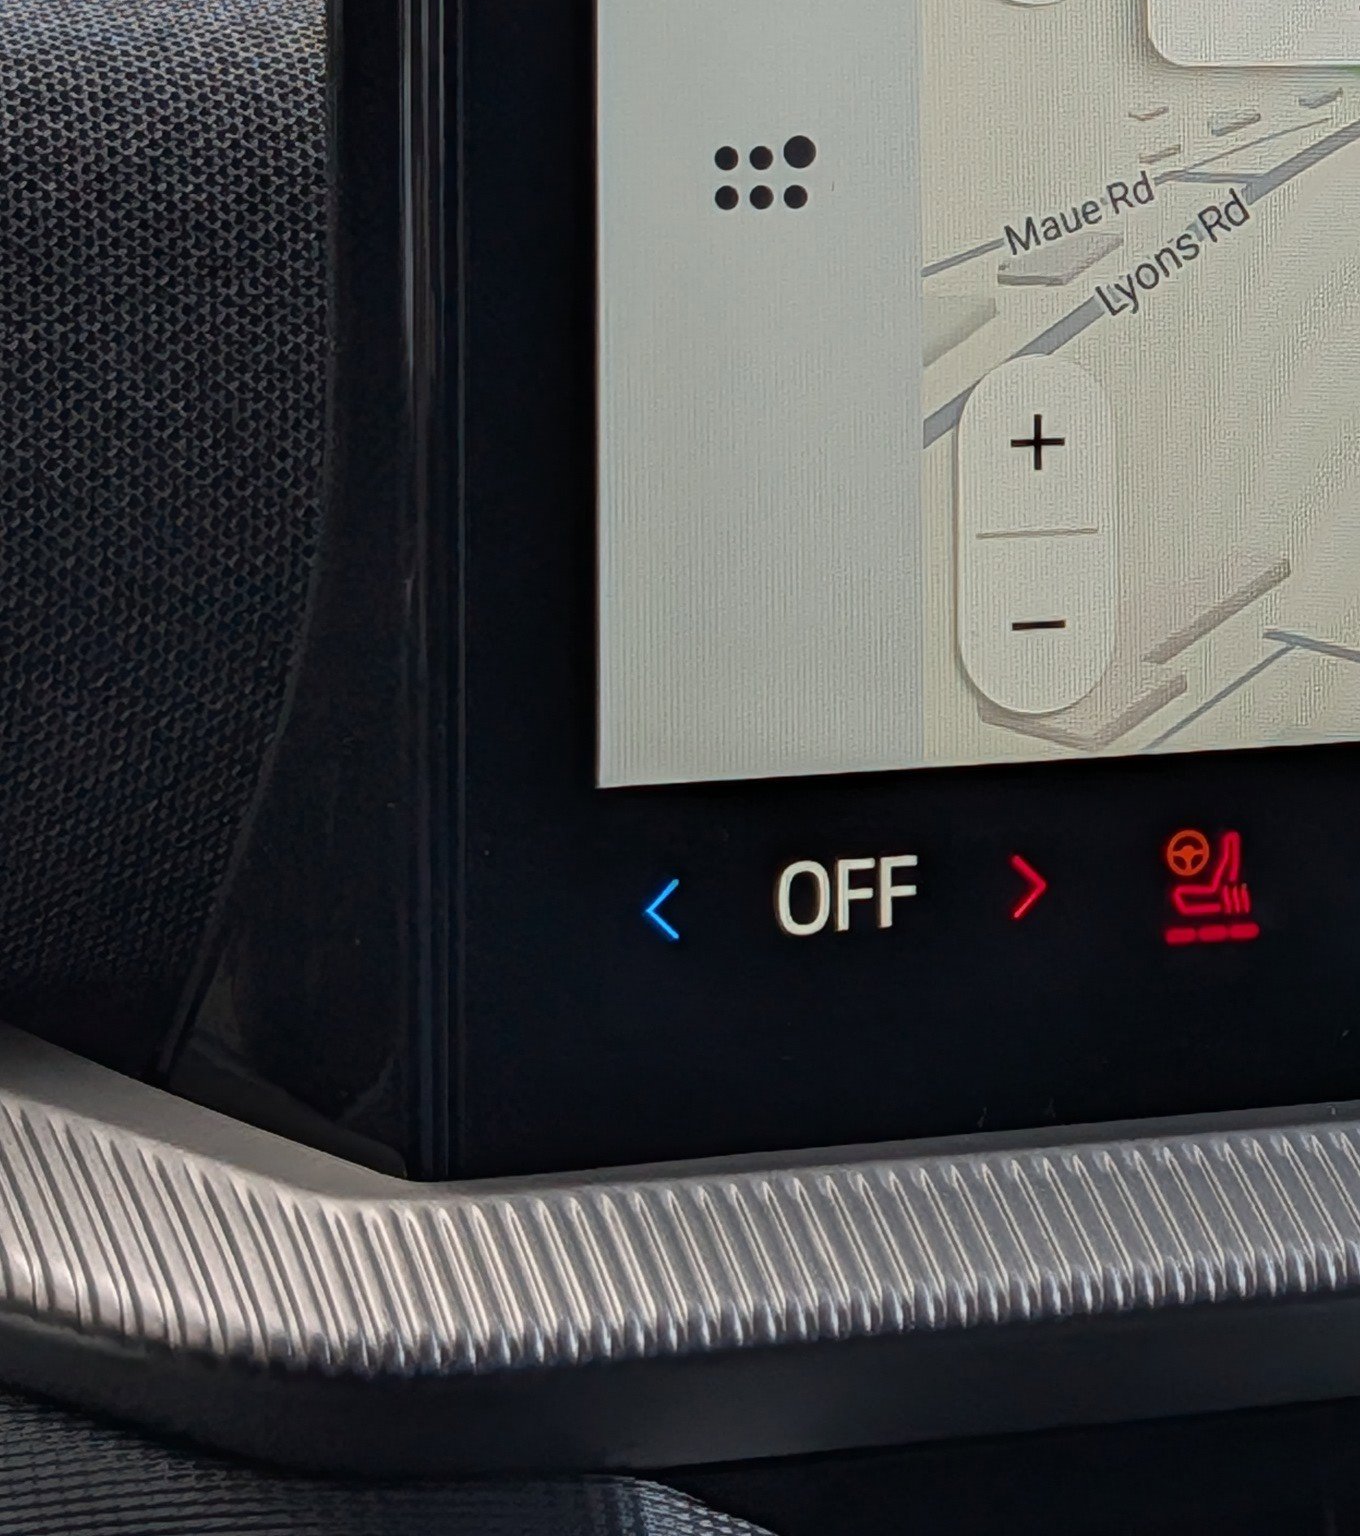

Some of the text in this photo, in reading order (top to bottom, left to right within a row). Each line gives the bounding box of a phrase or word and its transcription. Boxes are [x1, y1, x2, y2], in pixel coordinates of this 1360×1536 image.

[1004, 170, 1154, 255] Maue Rd
[1095, 188, 1250, 316] Lyons Rd
[776, 854, 918, 937] OFF
